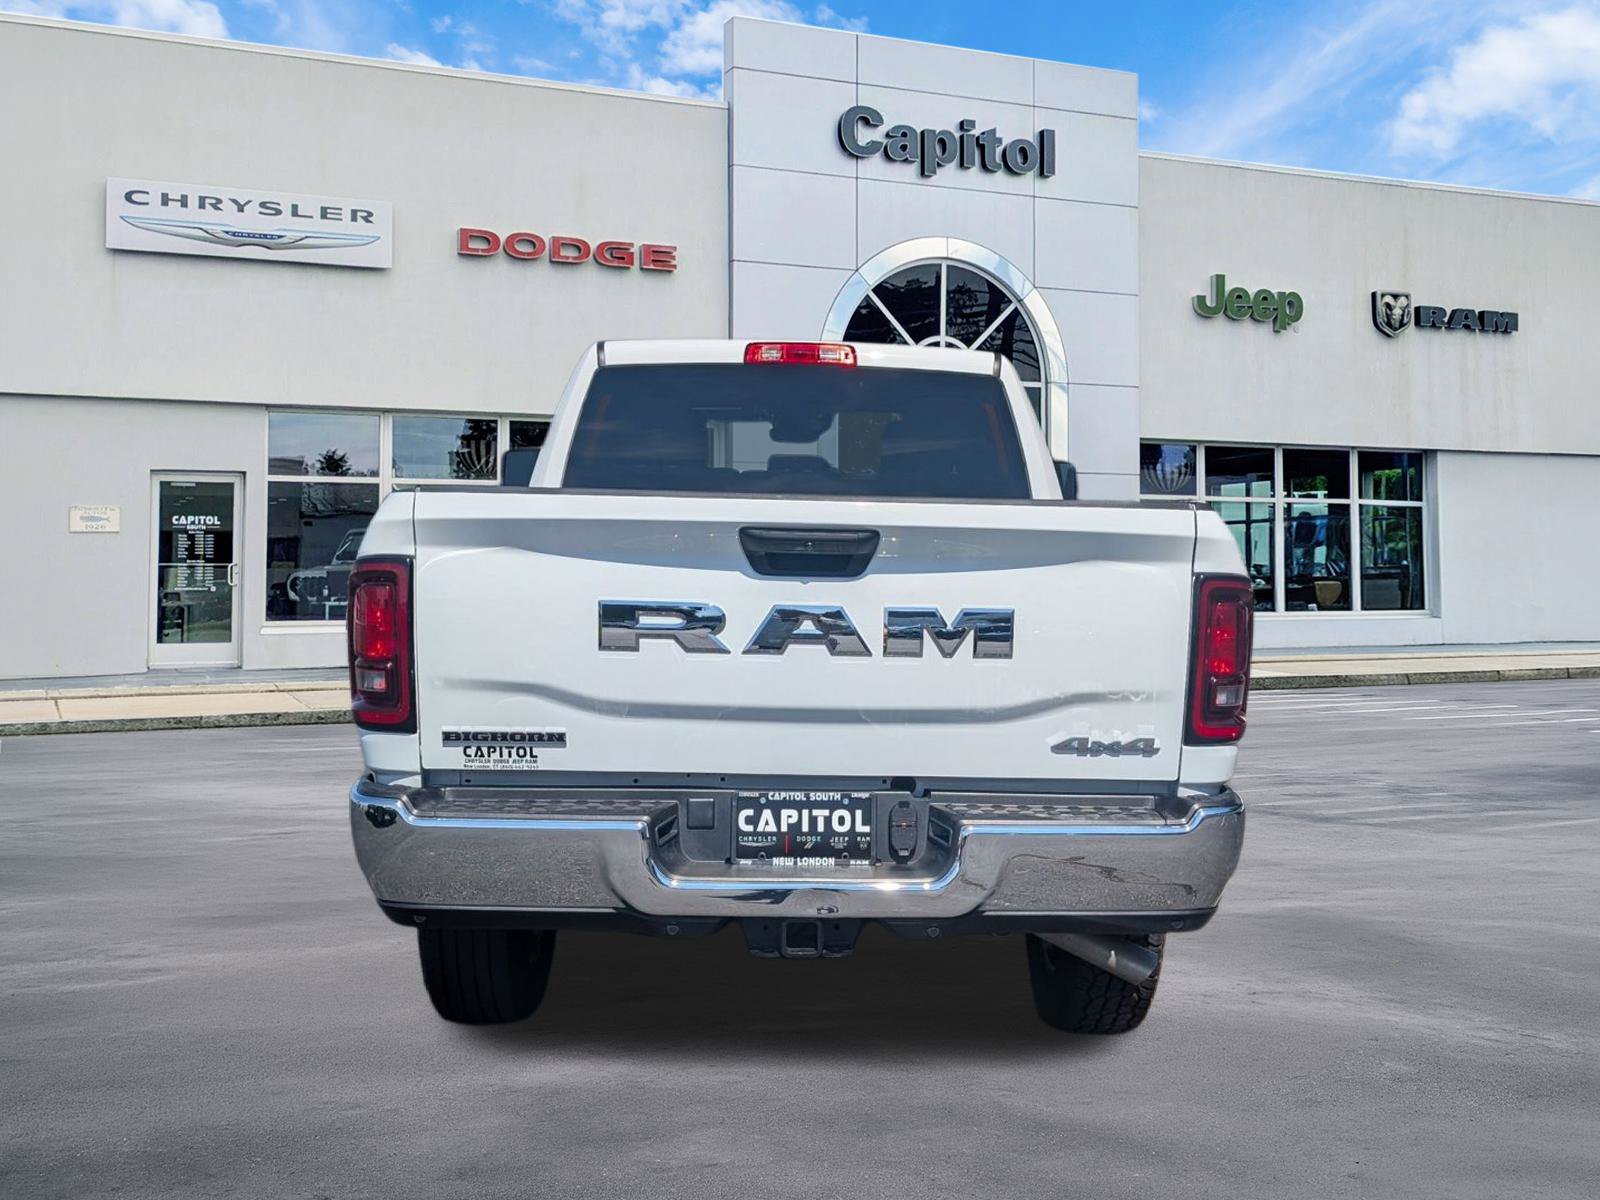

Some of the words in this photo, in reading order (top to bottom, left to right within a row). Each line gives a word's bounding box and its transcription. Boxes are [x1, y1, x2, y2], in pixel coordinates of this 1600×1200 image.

[838, 105, 1056, 178] Capitol
[124, 189, 376, 224] CHRYSLER
[457, 227, 678, 272] DODGE
[1192, 273, 1304, 333] Jeep
[1414, 304, 1519, 333] RAM
[172, 515, 221, 525] CAPITOL
[598, 600, 1016, 659] RAM
[441, 731, 567, 744] BIGHORN
[463, 745, 538, 758] CAPITOL
[768, 791, 807, 800] CAPITOL
[810, 792, 841, 801] SOUTH
[738, 809, 871, 833] CAPITOL
[772, 857, 794, 866] NEW
[797, 857, 835, 866] LONDON
